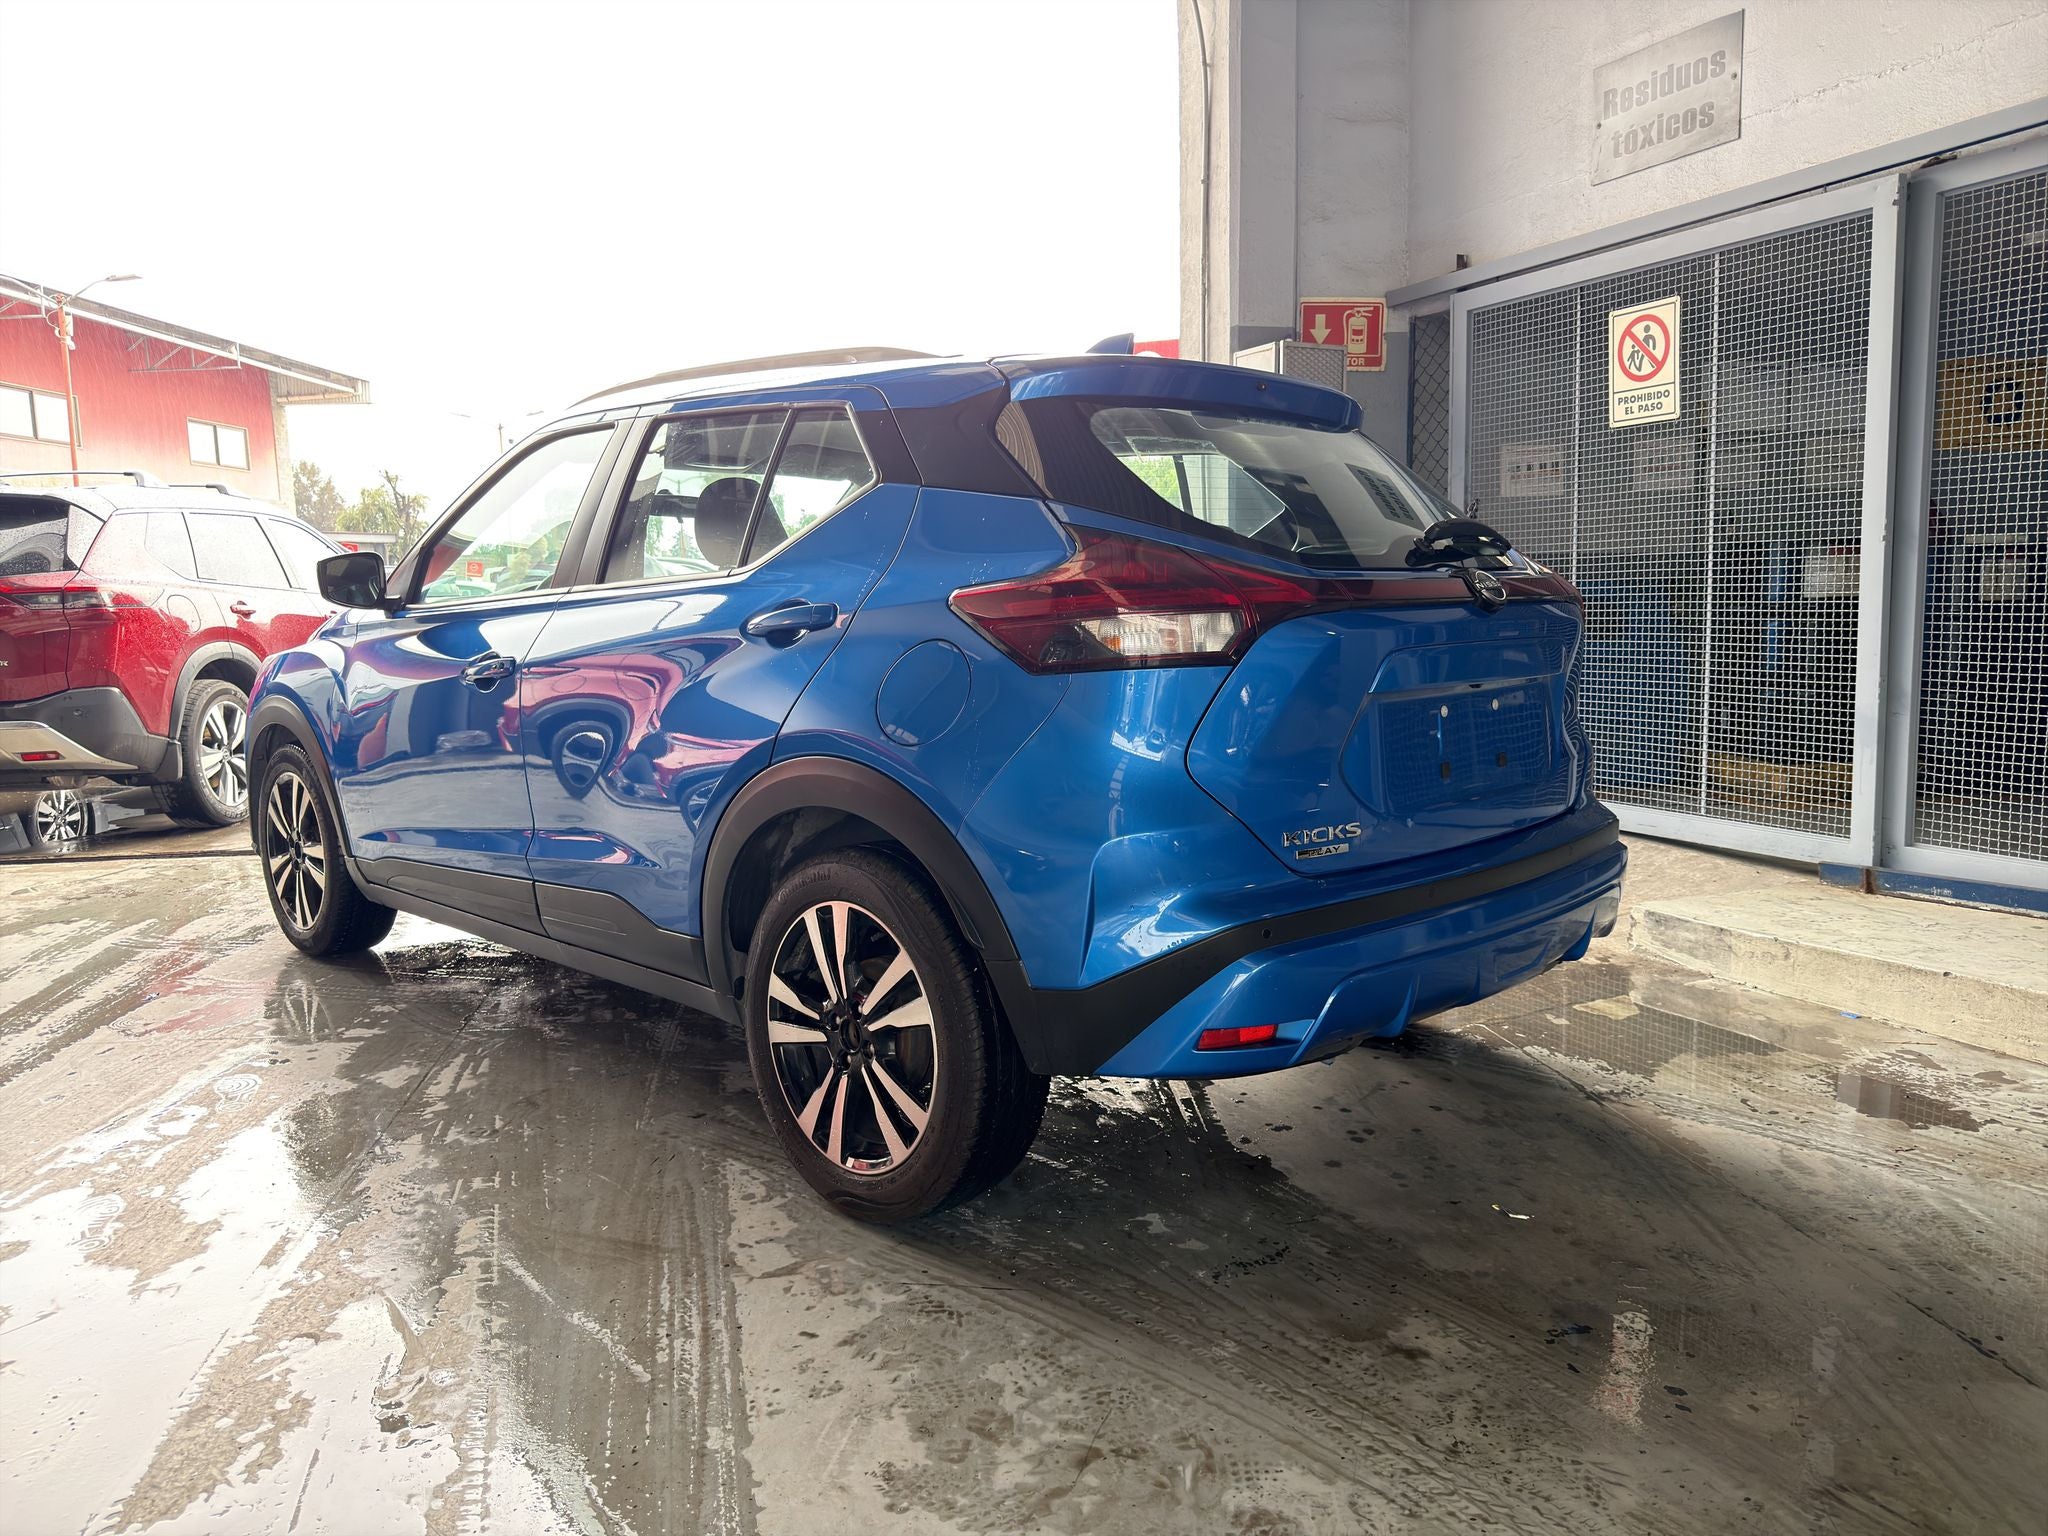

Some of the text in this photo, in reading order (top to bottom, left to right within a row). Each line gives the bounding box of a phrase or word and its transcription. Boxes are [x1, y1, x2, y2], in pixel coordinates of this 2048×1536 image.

[1604, 50, 1726, 120] Residuos
[1611, 101, 1715, 159] tóxicos
[1618, 389, 1670, 406] PROHIBIDO
[1625, 401, 1663, 415] EL PASO
[1282, 822, 1361, 847] KICKS
